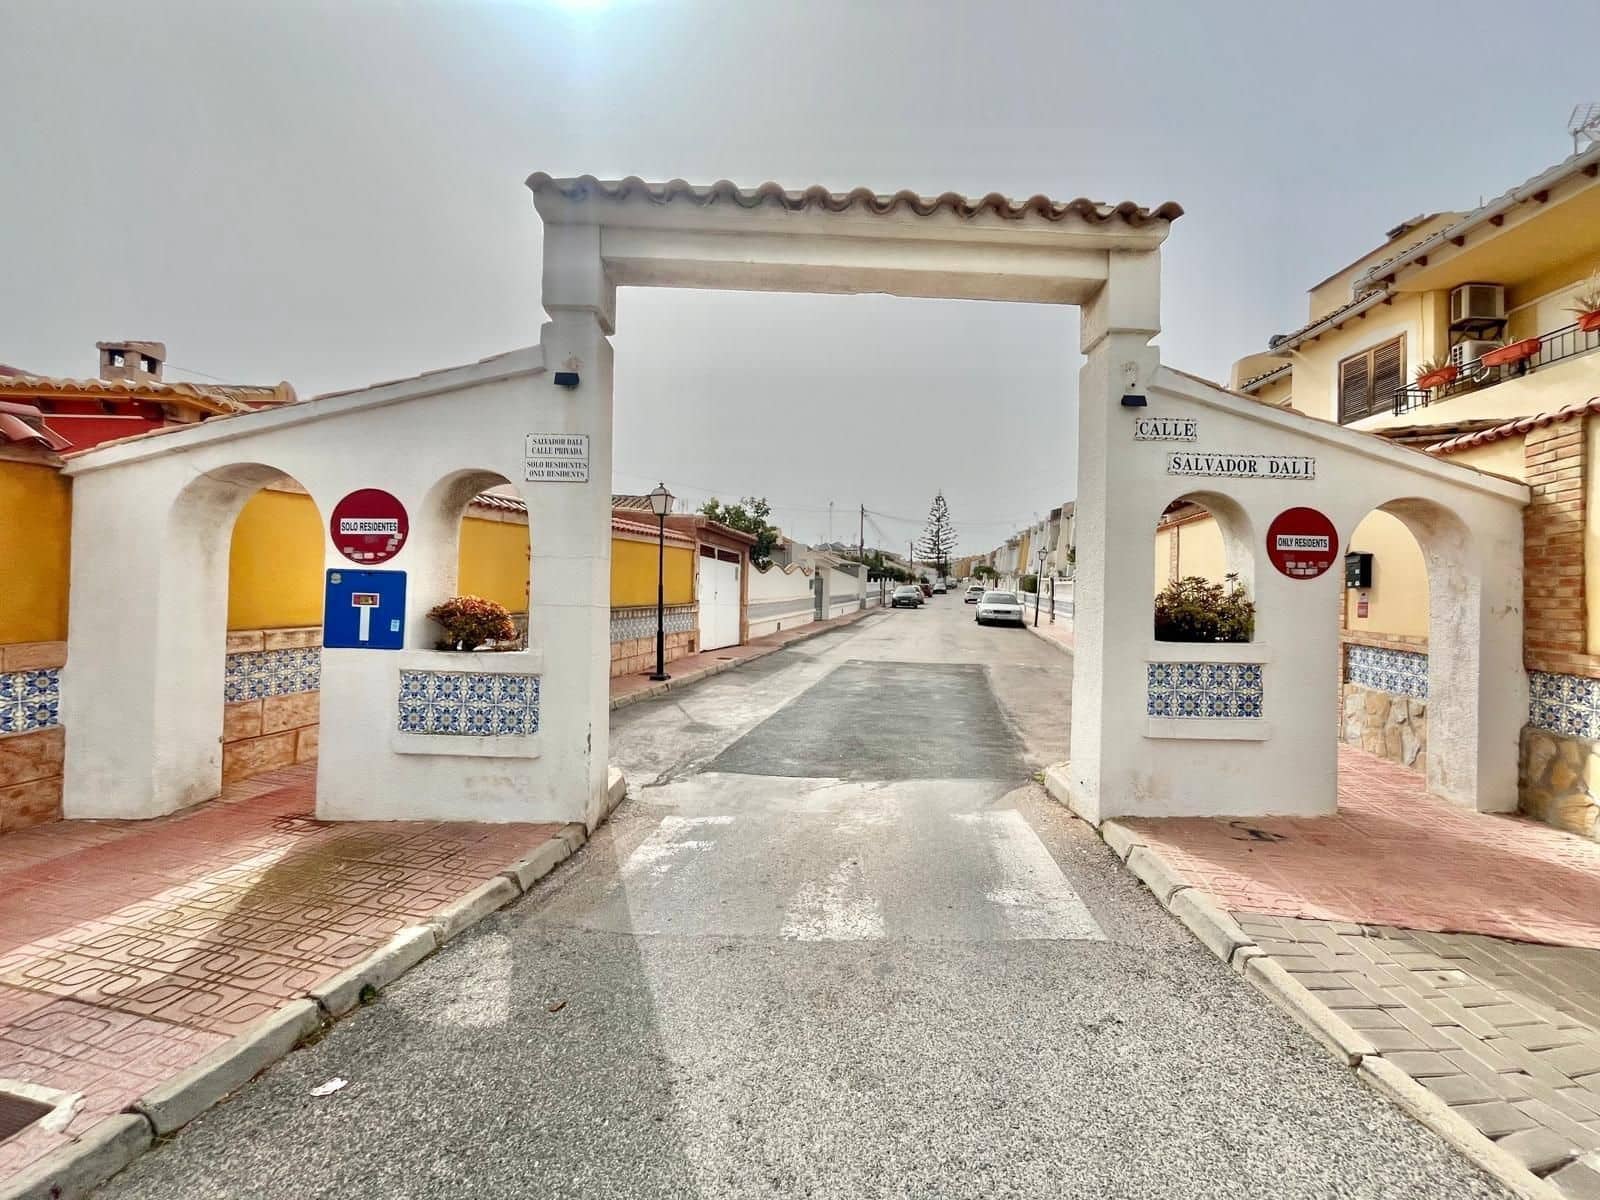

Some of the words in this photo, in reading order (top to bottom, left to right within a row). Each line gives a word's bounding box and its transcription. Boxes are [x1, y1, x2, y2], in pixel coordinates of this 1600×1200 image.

[1139, 422, 1194, 437] CALLE
[532, 438, 566, 446] SALVADOR
[567, 438, 583, 446] DALI
[531, 446, 553, 455] CALLE
[554, 447, 584, 455] PRIVADA
[545, 461, 588, 469] RESIDENTES
[1172, 457, 1258, 473] SALVADOR
[1269, 460, 1309, 475] DALI
[546, 470, 585, 478] RESIDENTS
[341, 522, 358, 531] SOLO
[359, 522, 397, 532] RESIDENTES
[1278, 537, 1294, 547] ONLY
[1294, 538, 1328, 548] RESIDENTS
